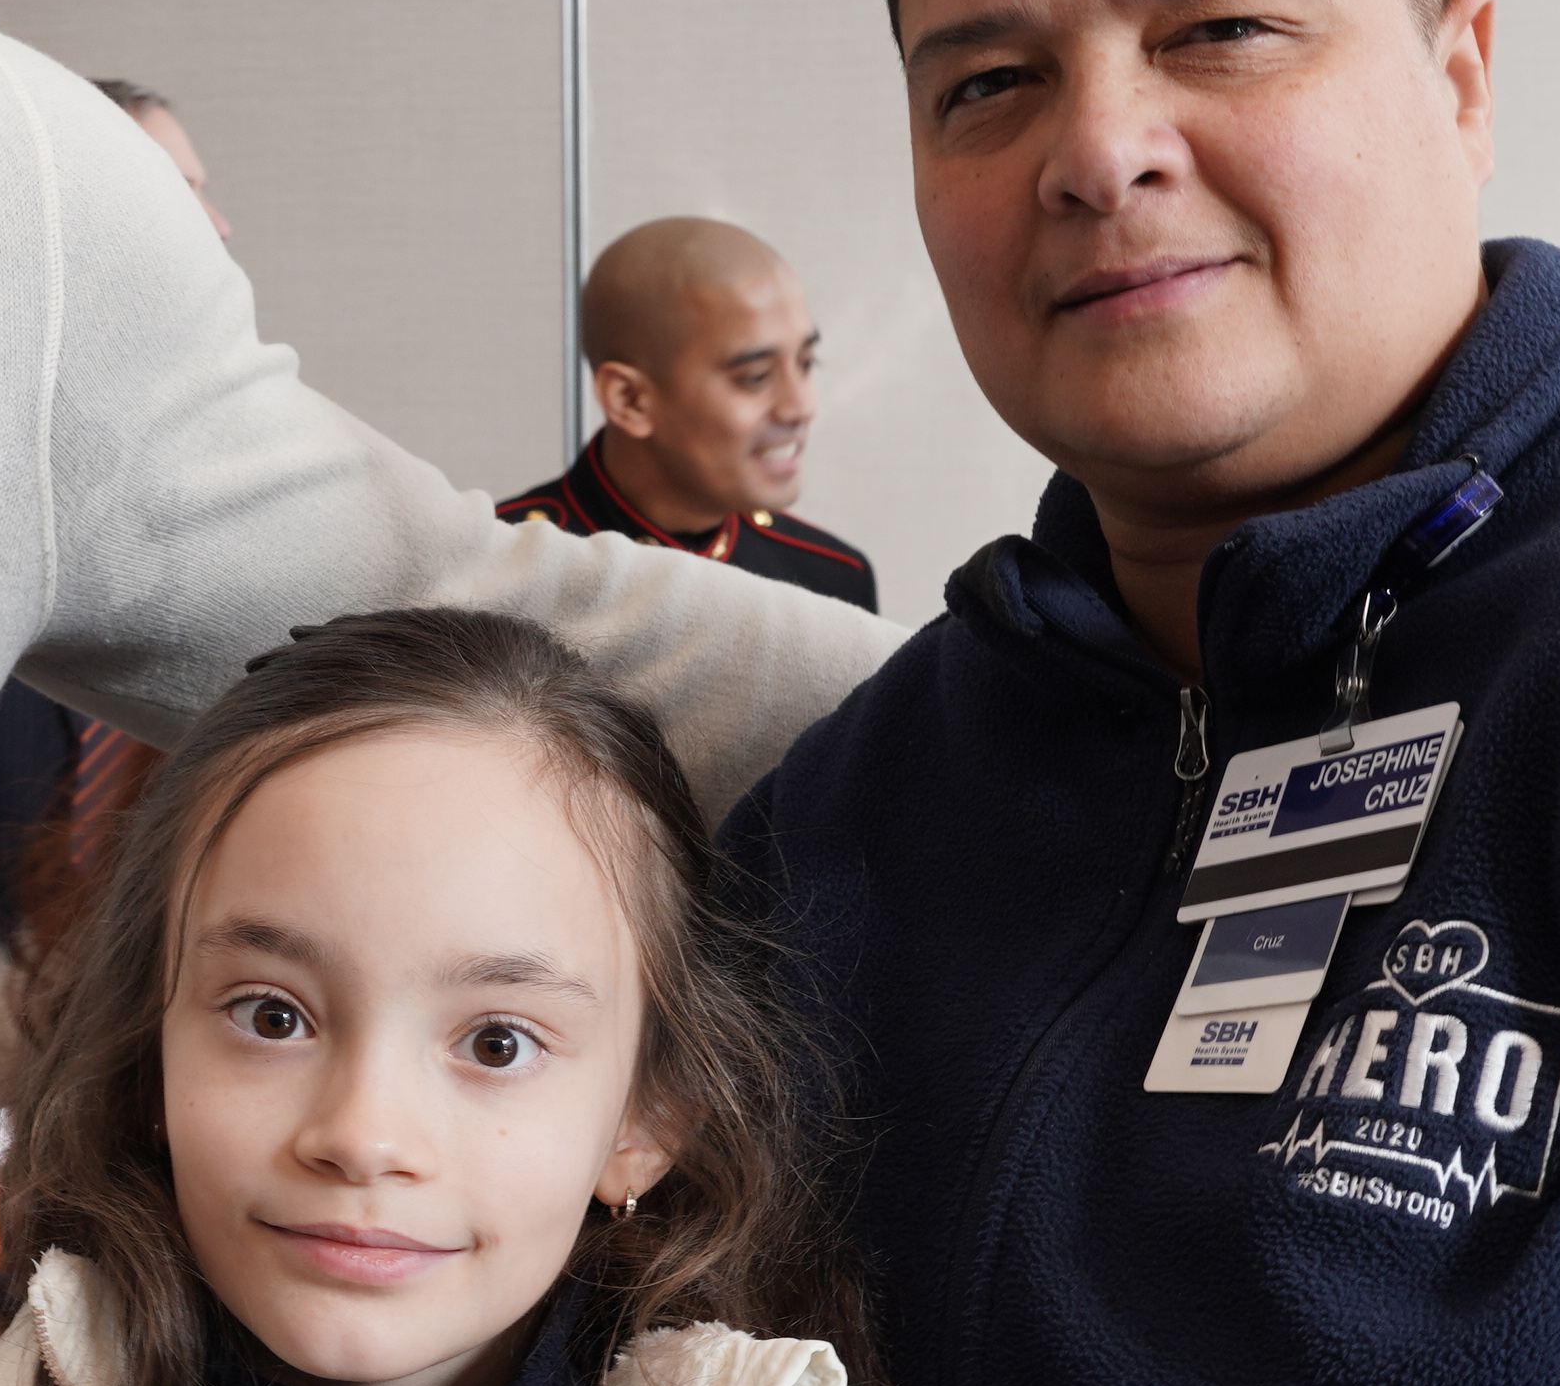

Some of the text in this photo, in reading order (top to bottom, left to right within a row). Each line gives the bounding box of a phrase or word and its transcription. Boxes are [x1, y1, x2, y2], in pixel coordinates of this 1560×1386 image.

[1309, 736, 1444, 792] JOSEPHINE
[1218, 782, 1283, 816] SBH
[1364, 772, 1433, 812] CRUZ
[1253, 934, 1285, 951] Cruz
[1391, 943, 1463, 976] SBH
[1200, 1021, 1258, 1043] SBH
[1296, 1010, 1543, 1132] HERO
[1355, 1116, 1423, 1150] 2020
[1297, 1167, 1456, 1229] #SBHStrong
